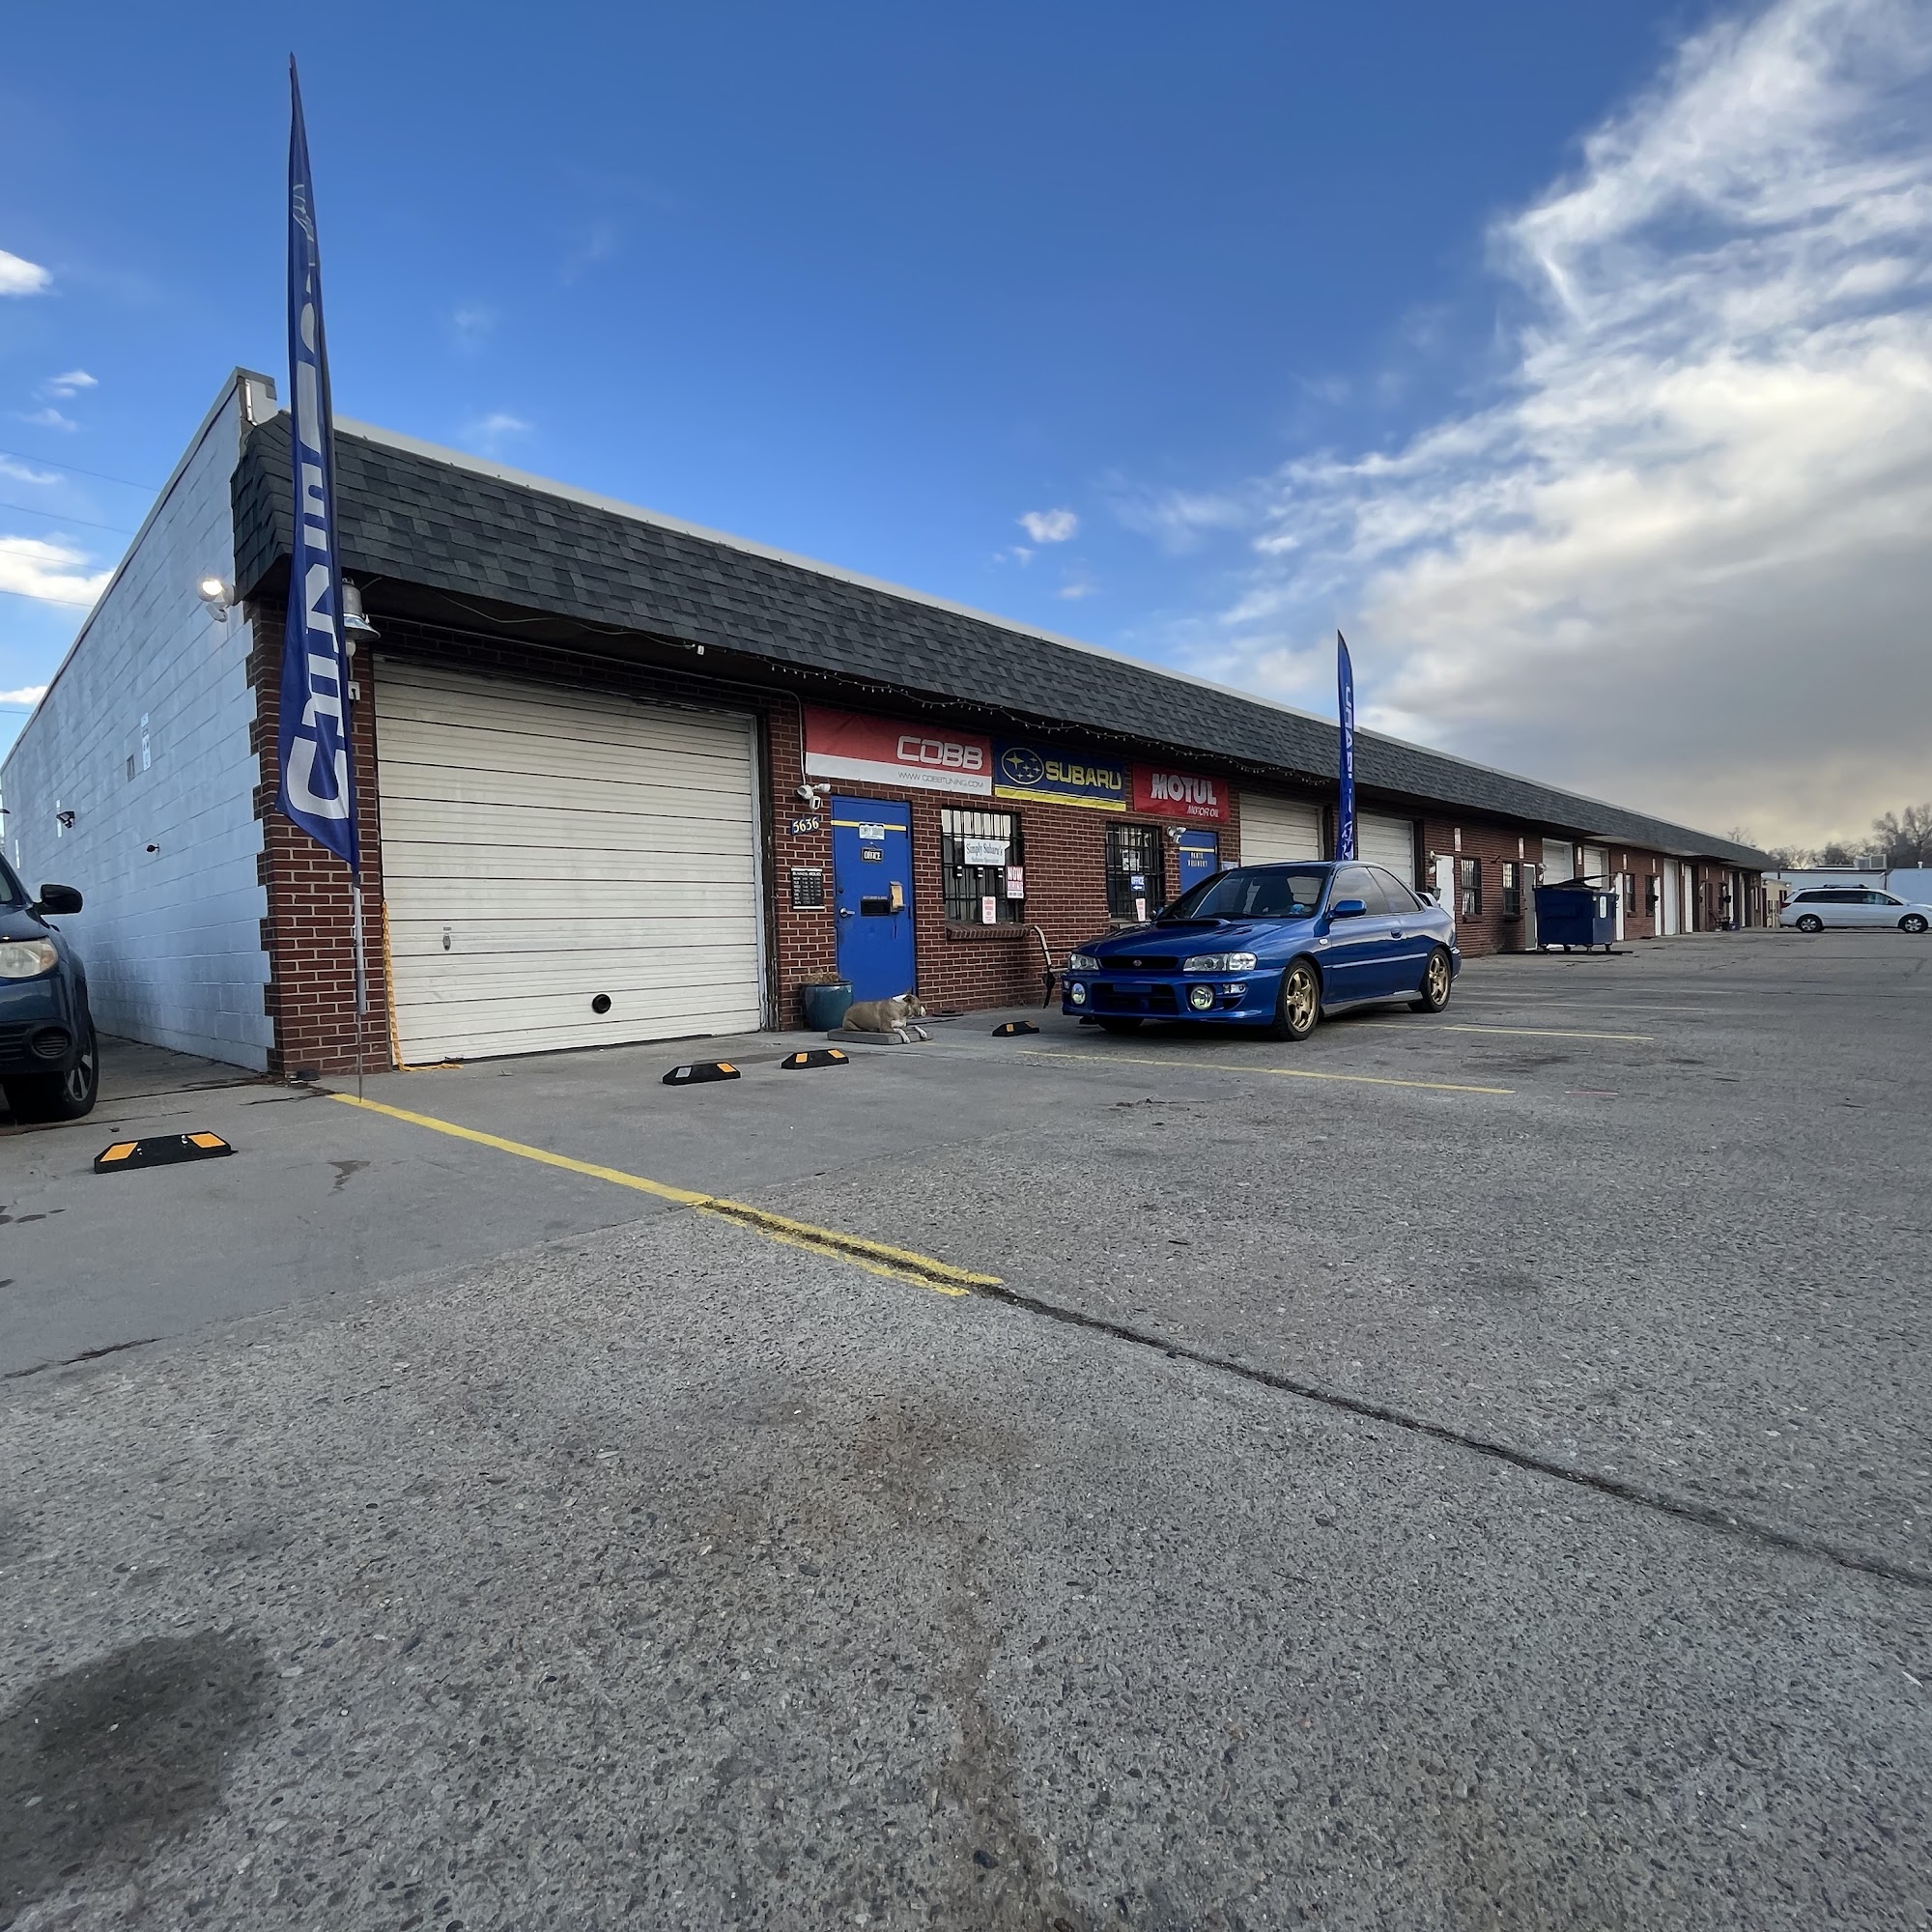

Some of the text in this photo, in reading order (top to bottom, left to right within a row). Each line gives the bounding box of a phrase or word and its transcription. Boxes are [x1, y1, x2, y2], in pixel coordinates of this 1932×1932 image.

[896, 735, 983, 770] COBB
[1045, 761, 1122, 790] SUBARU
[1150, 774, 1217, 806] MOTUL
[1187, 805, 1219, 818] MOTOR OIL
[793, 816, 819, 833] 5636
[864, 850, 882, 861] OFFICE
[1007, 866, 1023, 881] NOW
